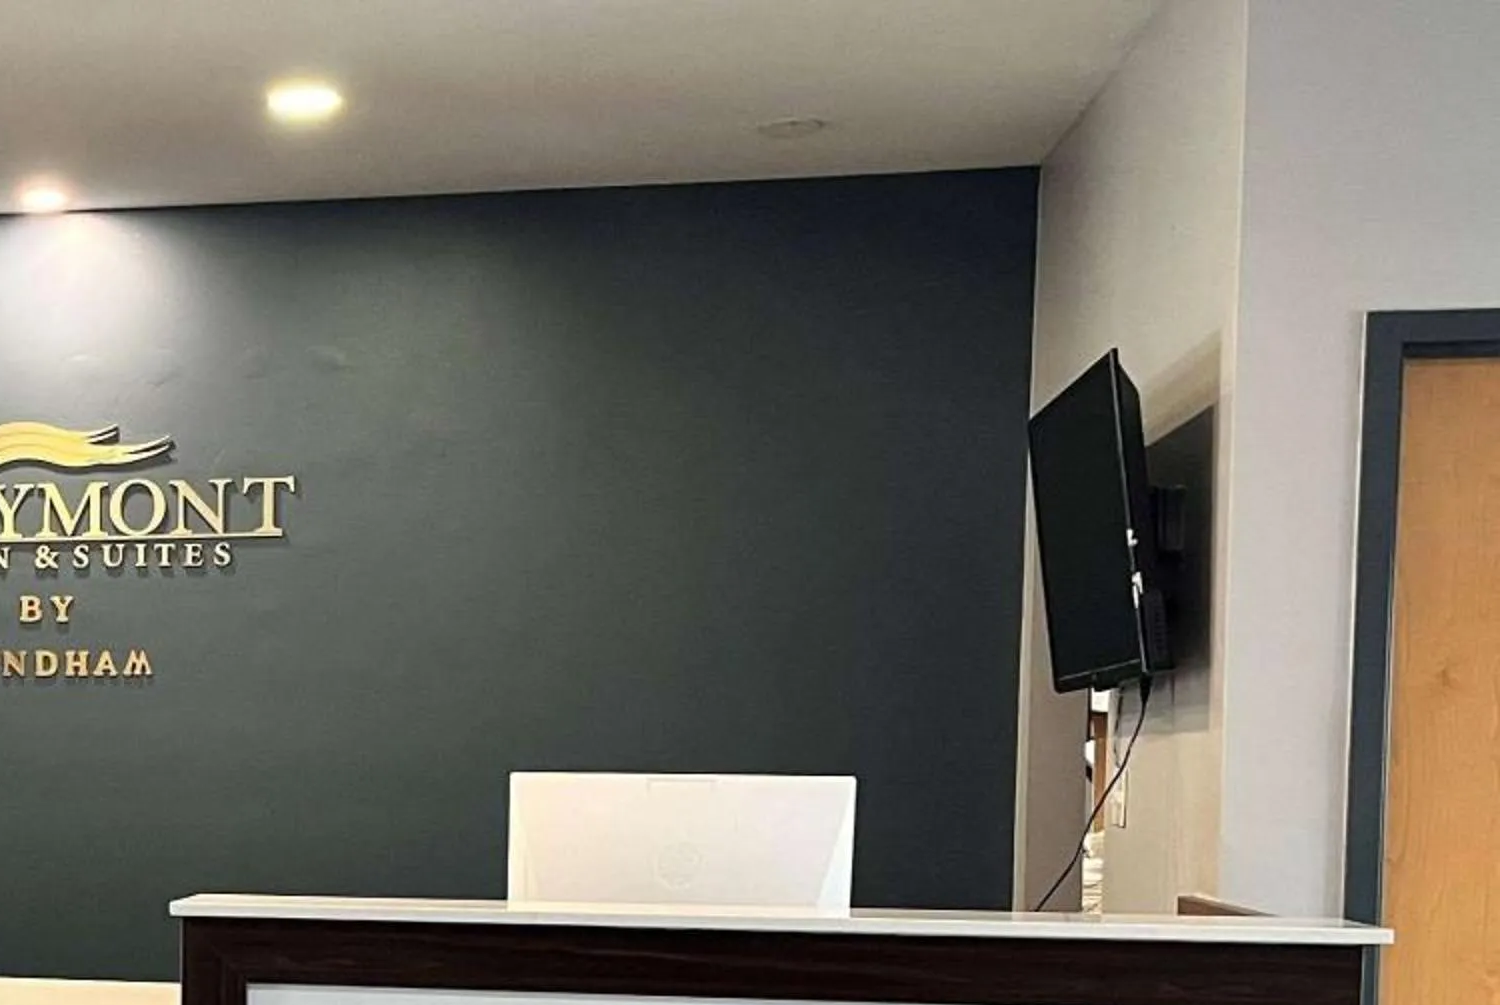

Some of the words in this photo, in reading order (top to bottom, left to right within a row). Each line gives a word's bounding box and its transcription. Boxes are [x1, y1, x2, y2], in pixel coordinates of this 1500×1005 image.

[34, 545, 60, 569] &
[73, 542, 233, 569] SUITES
[19, 595, 75, 624] BY
